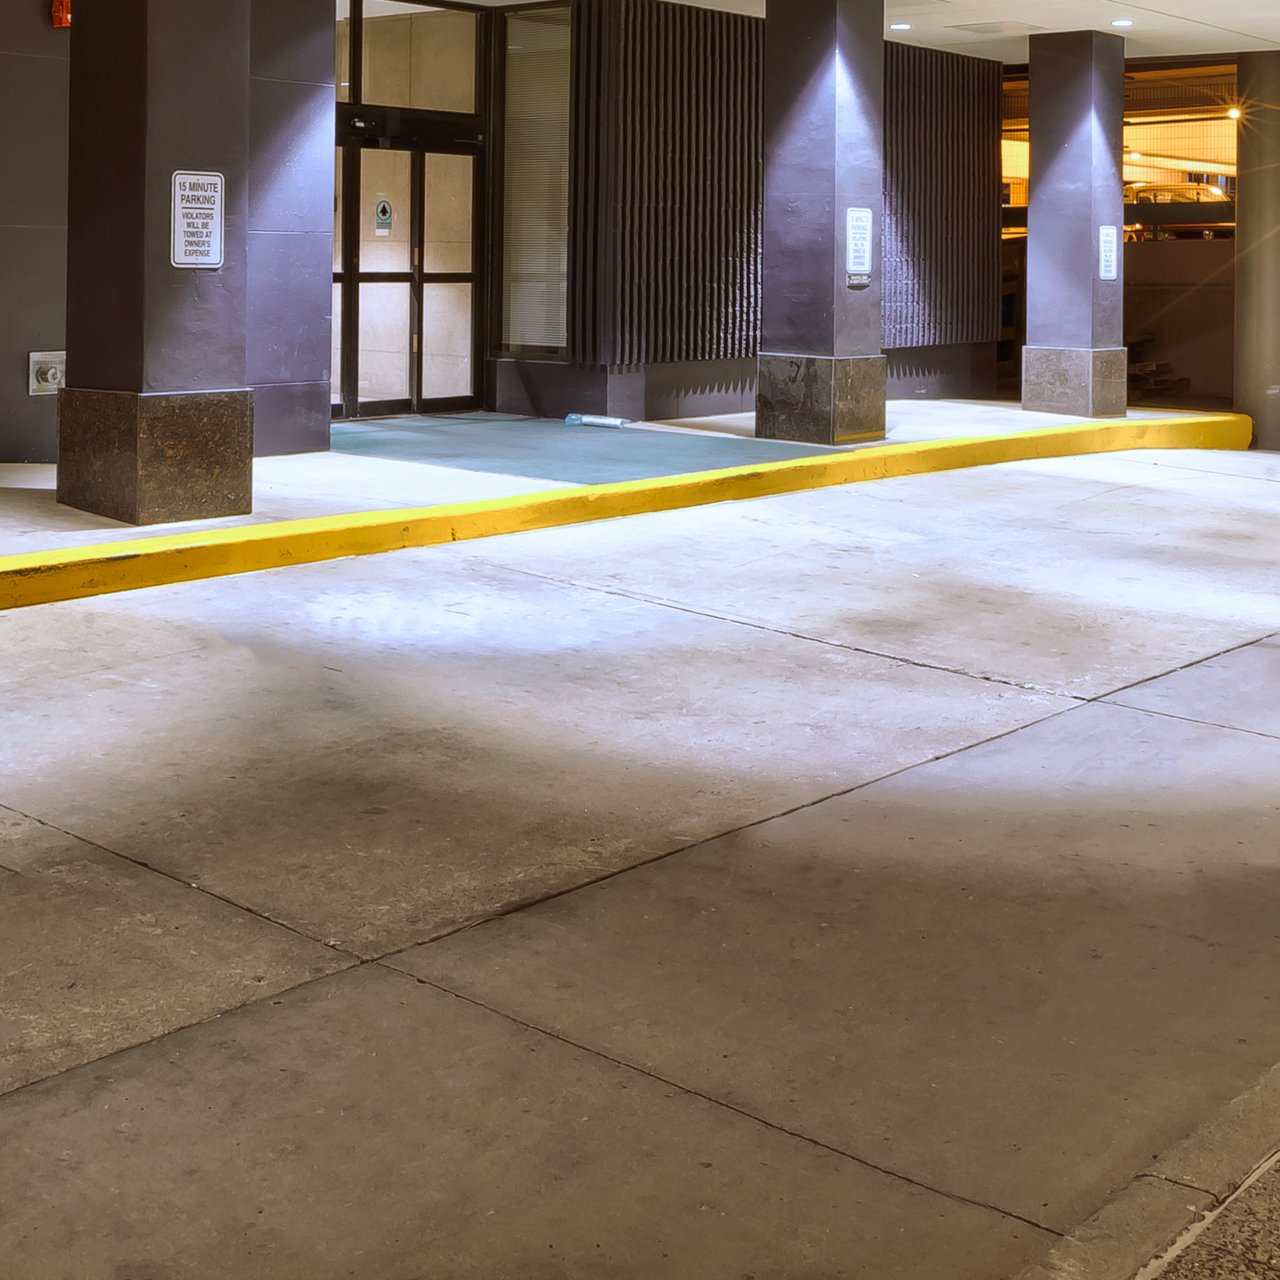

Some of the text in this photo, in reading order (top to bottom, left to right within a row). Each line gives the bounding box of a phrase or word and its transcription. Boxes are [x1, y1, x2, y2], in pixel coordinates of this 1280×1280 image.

[179, 182, 218, 193] 15 MINUTE
[180, 194, 215, 205] PARKING
[182, 212, 214, 220] VIOLATORS
[184, 249, 210, 257] EXPENSE
